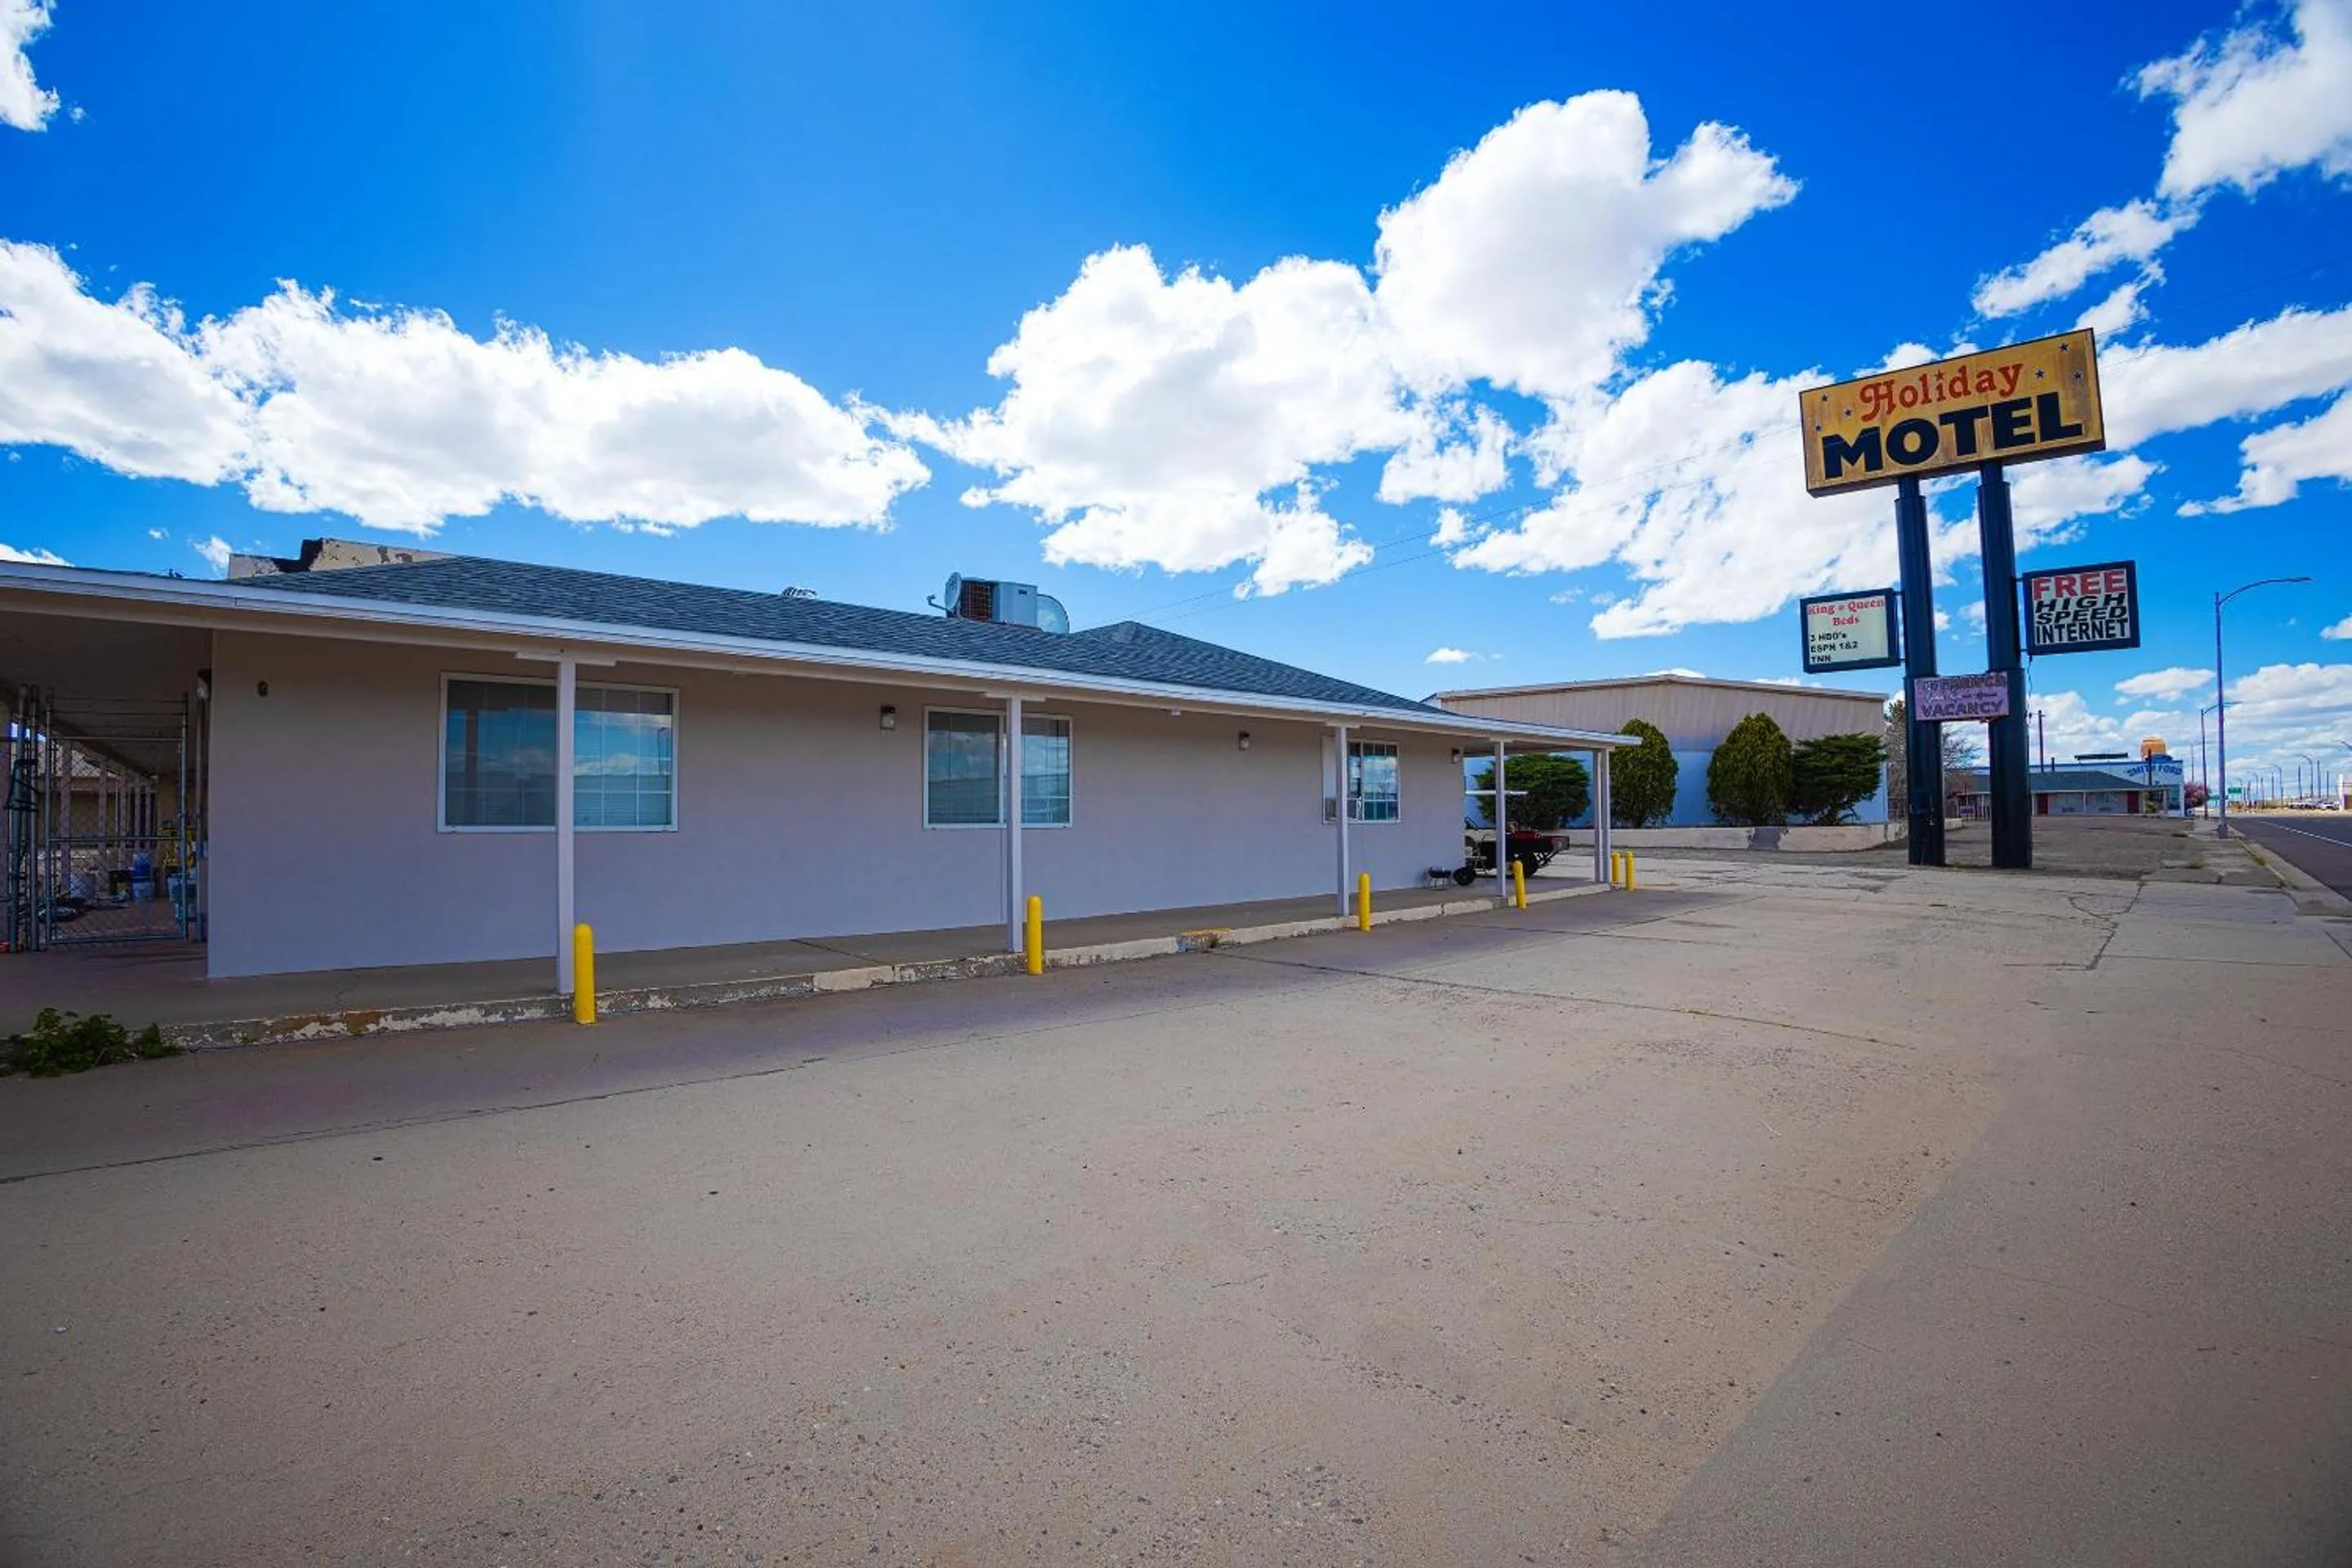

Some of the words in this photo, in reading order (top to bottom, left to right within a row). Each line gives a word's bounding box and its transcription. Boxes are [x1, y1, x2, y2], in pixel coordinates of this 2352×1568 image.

[1860, 363, 2024, 422] Holiday
[1821, 391, 2082, 479] MOTEL
[2034, 572, 2127, 599] FREE
[1807, 604, 1835, 615] King
[1848, 599, 1883, 612] Queen
[2035, 593, 2126, 612] HIGH
[1833, 616, 1860, 626] Beds
[2037, 607, 2127, 625] SPEED
[2036, 619, 2127, 644] INTERNET
[1811, 643, 1837, 653] ESPN
[1839, 641, 1859, 650] 1&2
[1920, 699, 2003, 718] VACANCY
